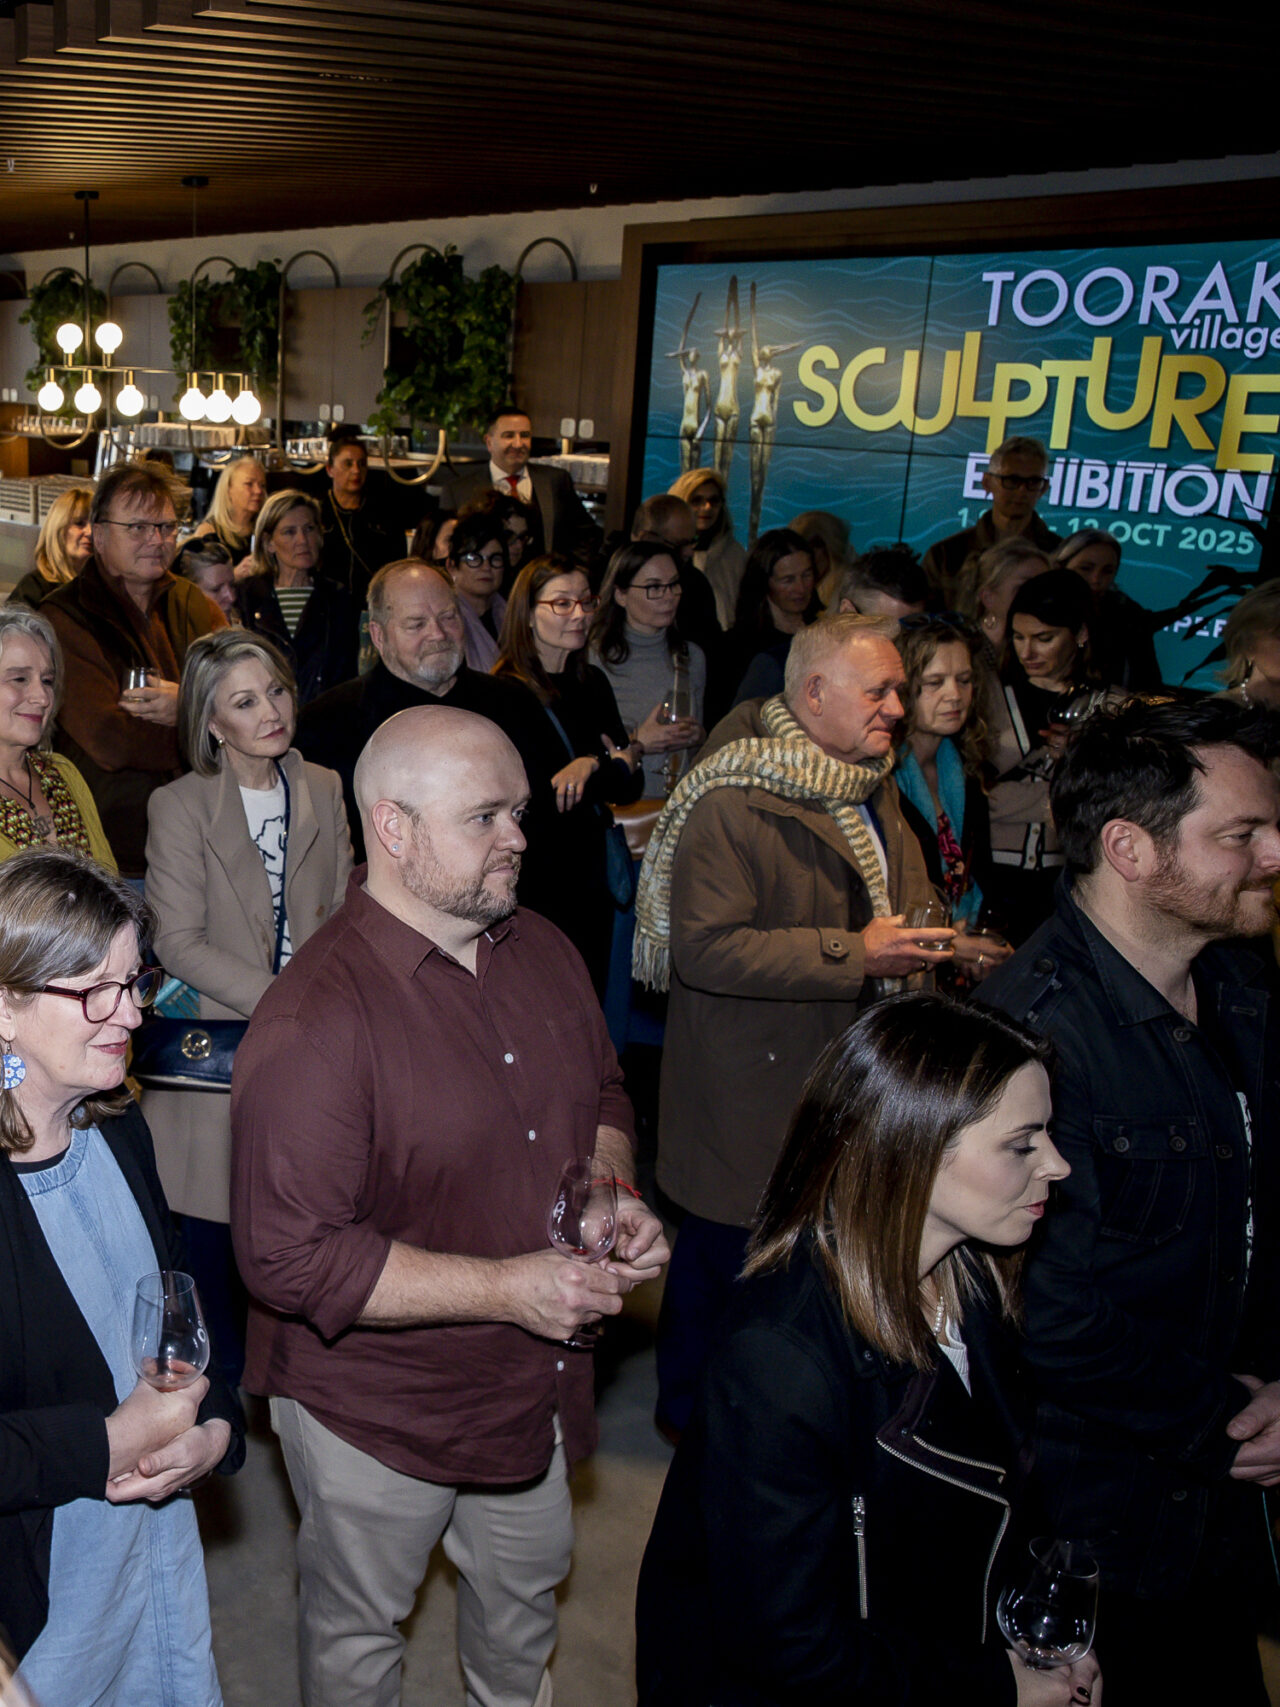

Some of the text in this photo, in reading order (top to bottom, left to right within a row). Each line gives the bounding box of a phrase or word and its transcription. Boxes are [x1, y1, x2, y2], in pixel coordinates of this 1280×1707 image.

[982, 260, 1280, 327] TOORAK
[793, 331, 1280, 471] SCULPTURE
[962, 452, 1270, 521] EHIBITION
[1108, 520, 1171, 547] OCT
[1179, 527, 1255, 555] 2025
